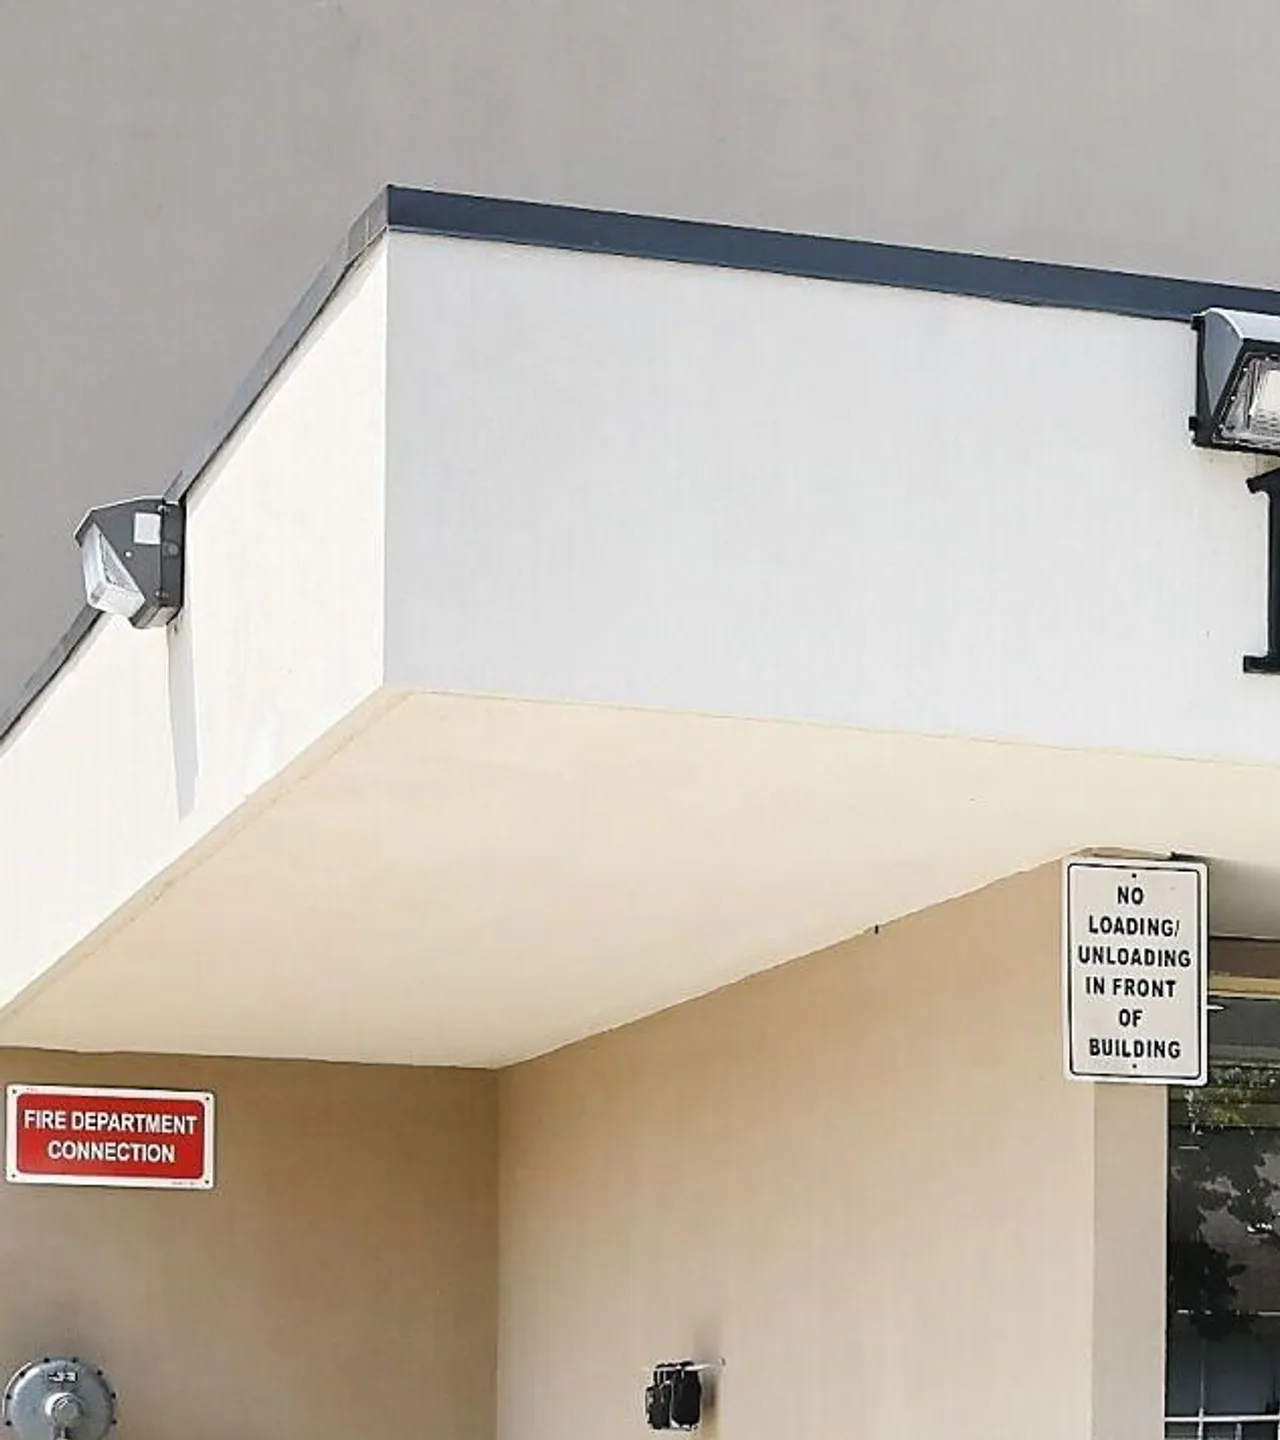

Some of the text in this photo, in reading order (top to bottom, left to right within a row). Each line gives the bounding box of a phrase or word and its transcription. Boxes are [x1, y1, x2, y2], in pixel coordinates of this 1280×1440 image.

[1117, 885, 1144, 906] NO
[1089, 914, 1181, 937] LOADING/
[1078, 945, 1192, 968] UNLOADING
[1085, 976, 1177, 998] IN FRONT
[1118, 1008, 1143, 1028] OF
[1089, 1038, 1181, 1060] BUILDING
[24, 1109, 197, 1134] FIRE DEPARTMENT
[47, 1140, 176, 1163] CONNECTION
